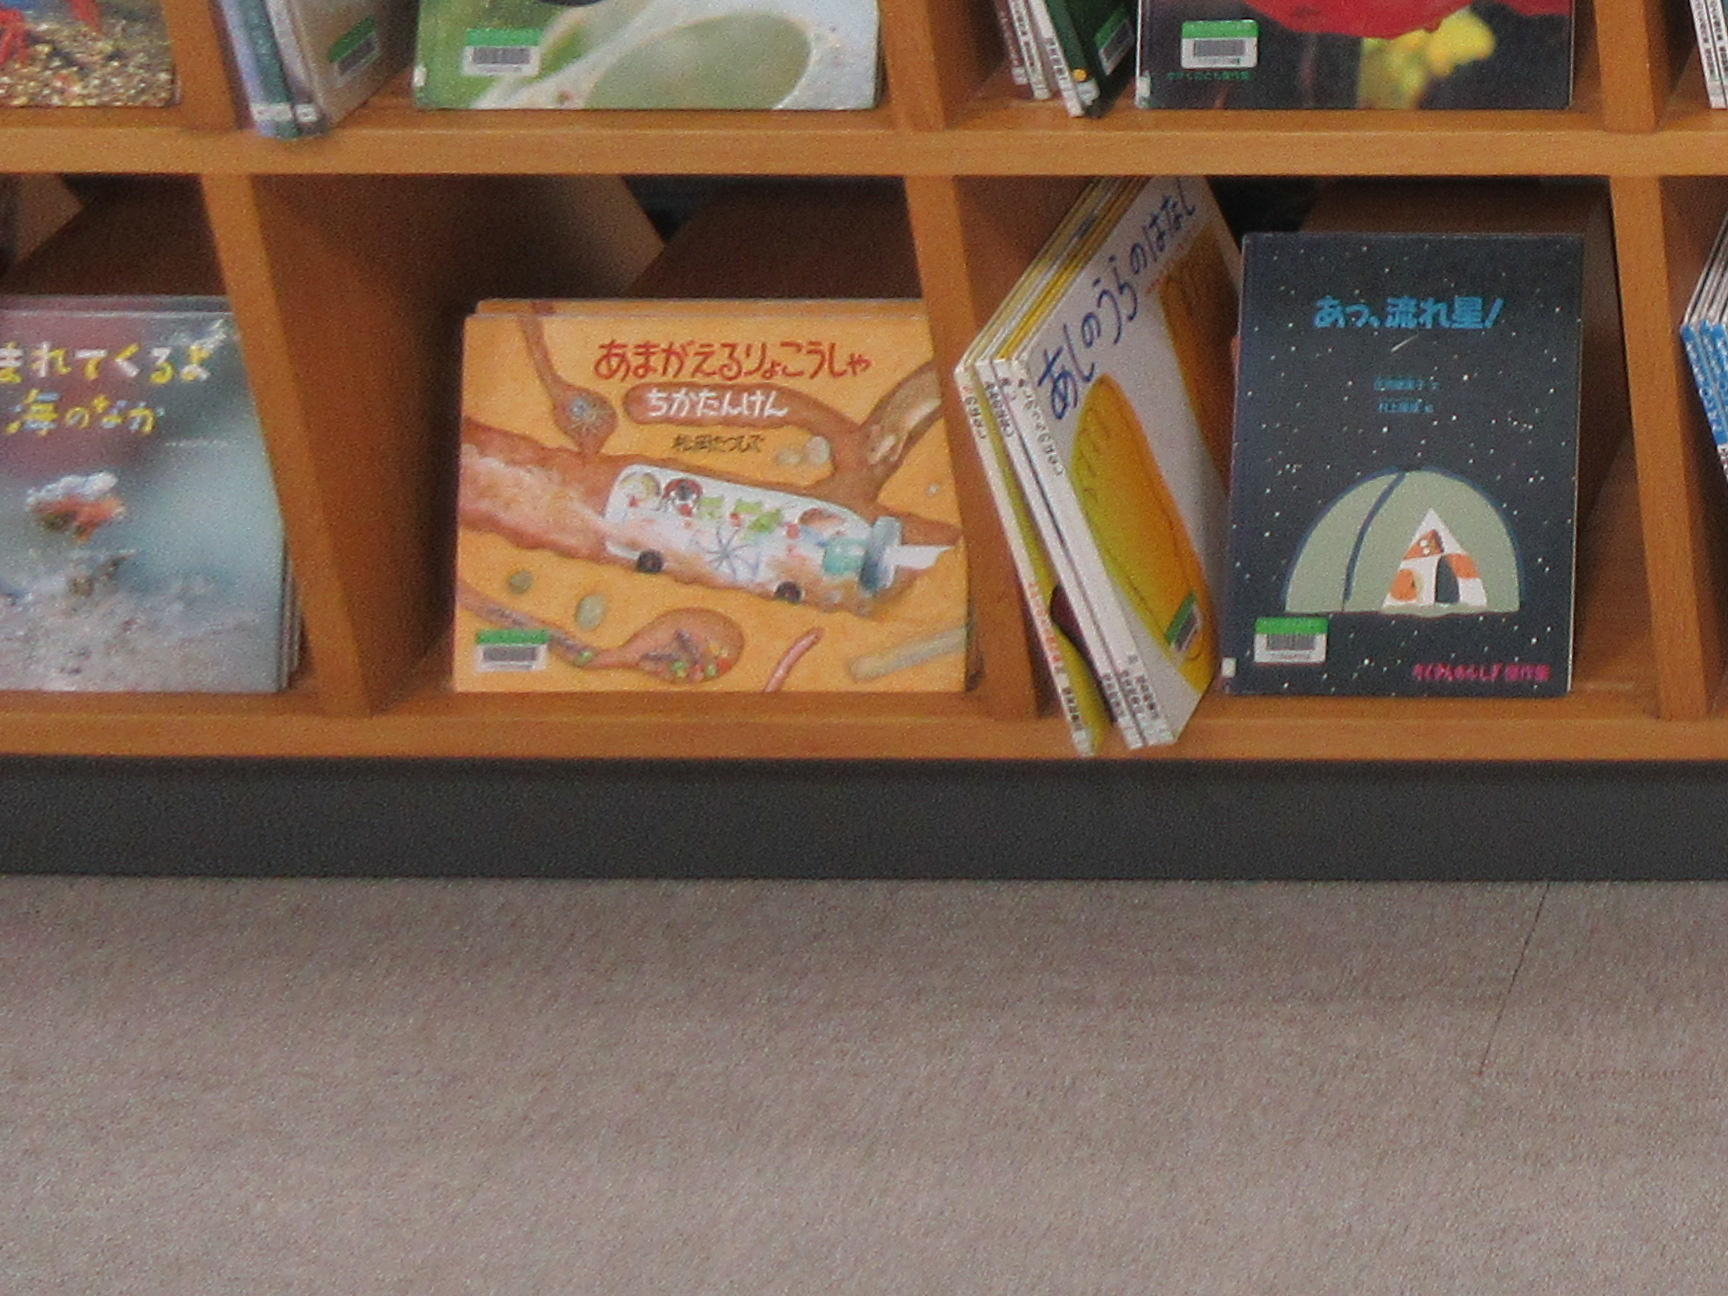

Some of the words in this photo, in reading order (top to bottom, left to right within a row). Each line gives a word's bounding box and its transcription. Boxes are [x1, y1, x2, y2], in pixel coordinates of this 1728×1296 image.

[1037, 197, 1198, 420] あしのうらのはなし
[1313, 297, 1507, 331] あっ、流れ星!
[593, 339, 873, 380] あまがえるりょこうしゃ
[646, 388, 789, 419] ちかたんけん
